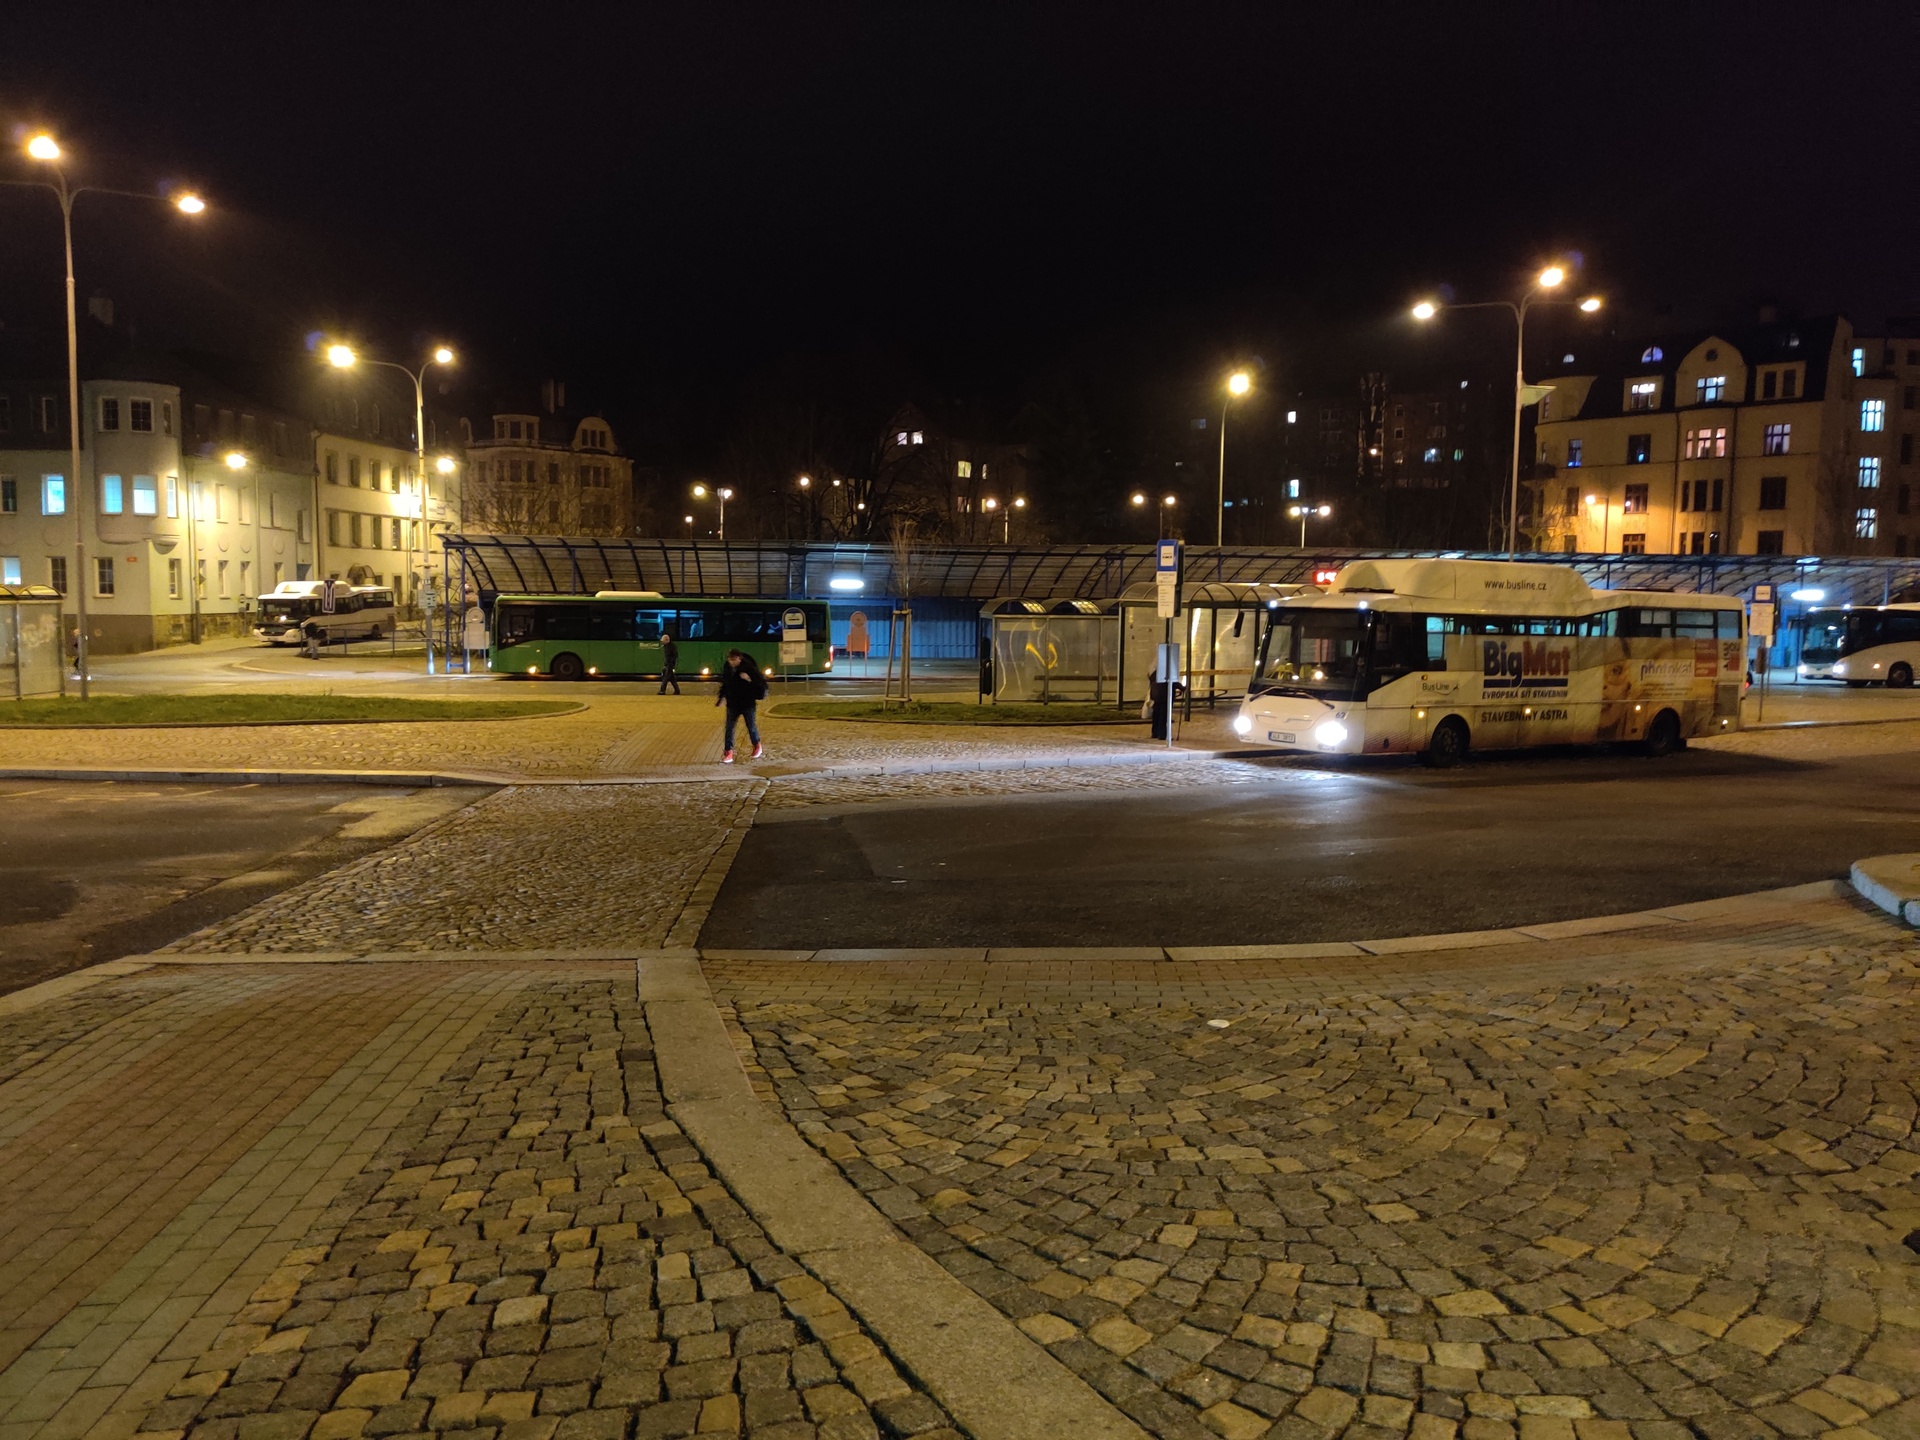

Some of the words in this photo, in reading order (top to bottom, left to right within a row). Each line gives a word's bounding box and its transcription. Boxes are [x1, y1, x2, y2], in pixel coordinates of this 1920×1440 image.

[1484, 580, 1547, 591] www.busline.cz
[1483, 640, 1571, 687] BigMat
[1540, 709, 1568, 721] ASTRA
